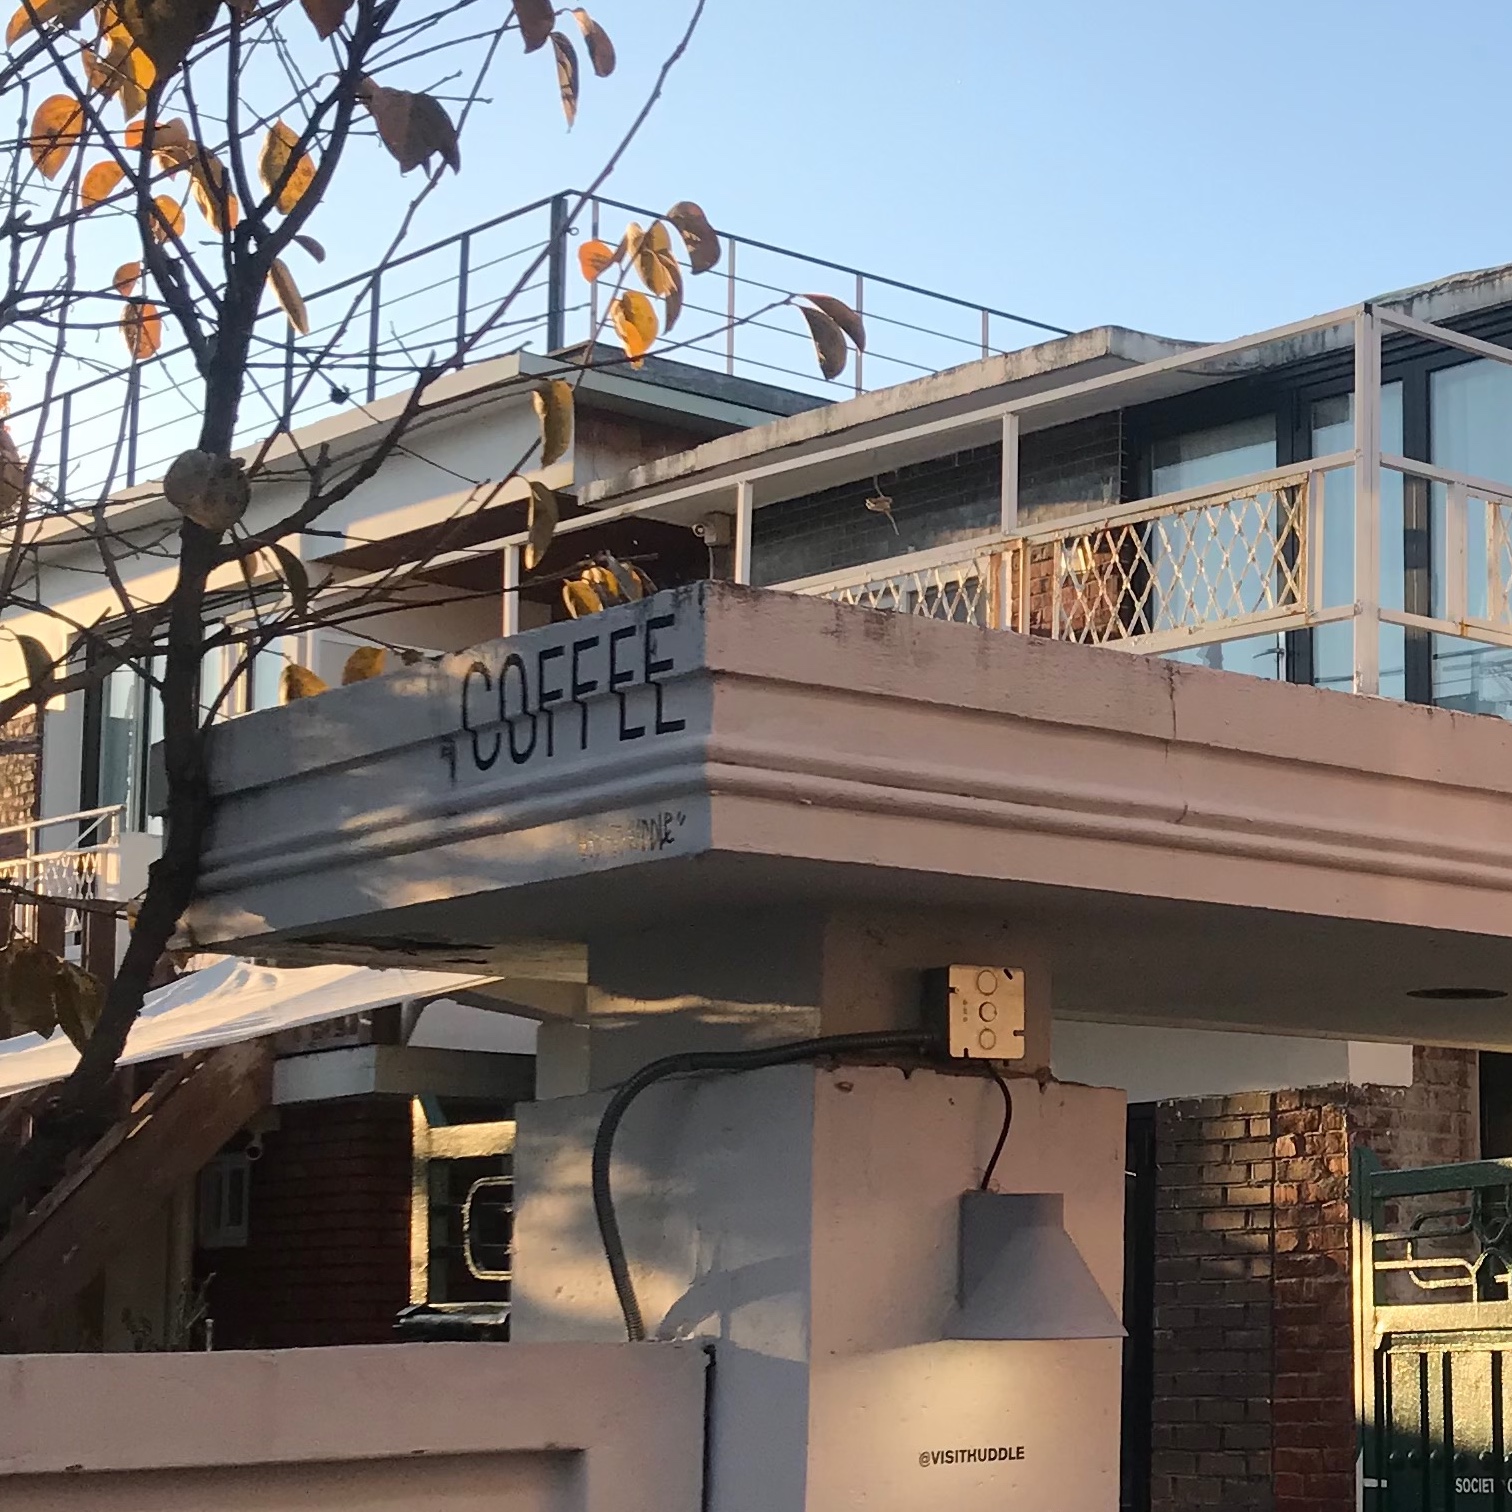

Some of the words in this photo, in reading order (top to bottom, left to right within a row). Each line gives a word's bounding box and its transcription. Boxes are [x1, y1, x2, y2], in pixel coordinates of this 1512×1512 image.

[462, 613, 686, 771] COFFEE
[918, 1446, 1026, 1468] @VISITHUDDLE
[1455, 1477, 1506, 1494] SOCIET
